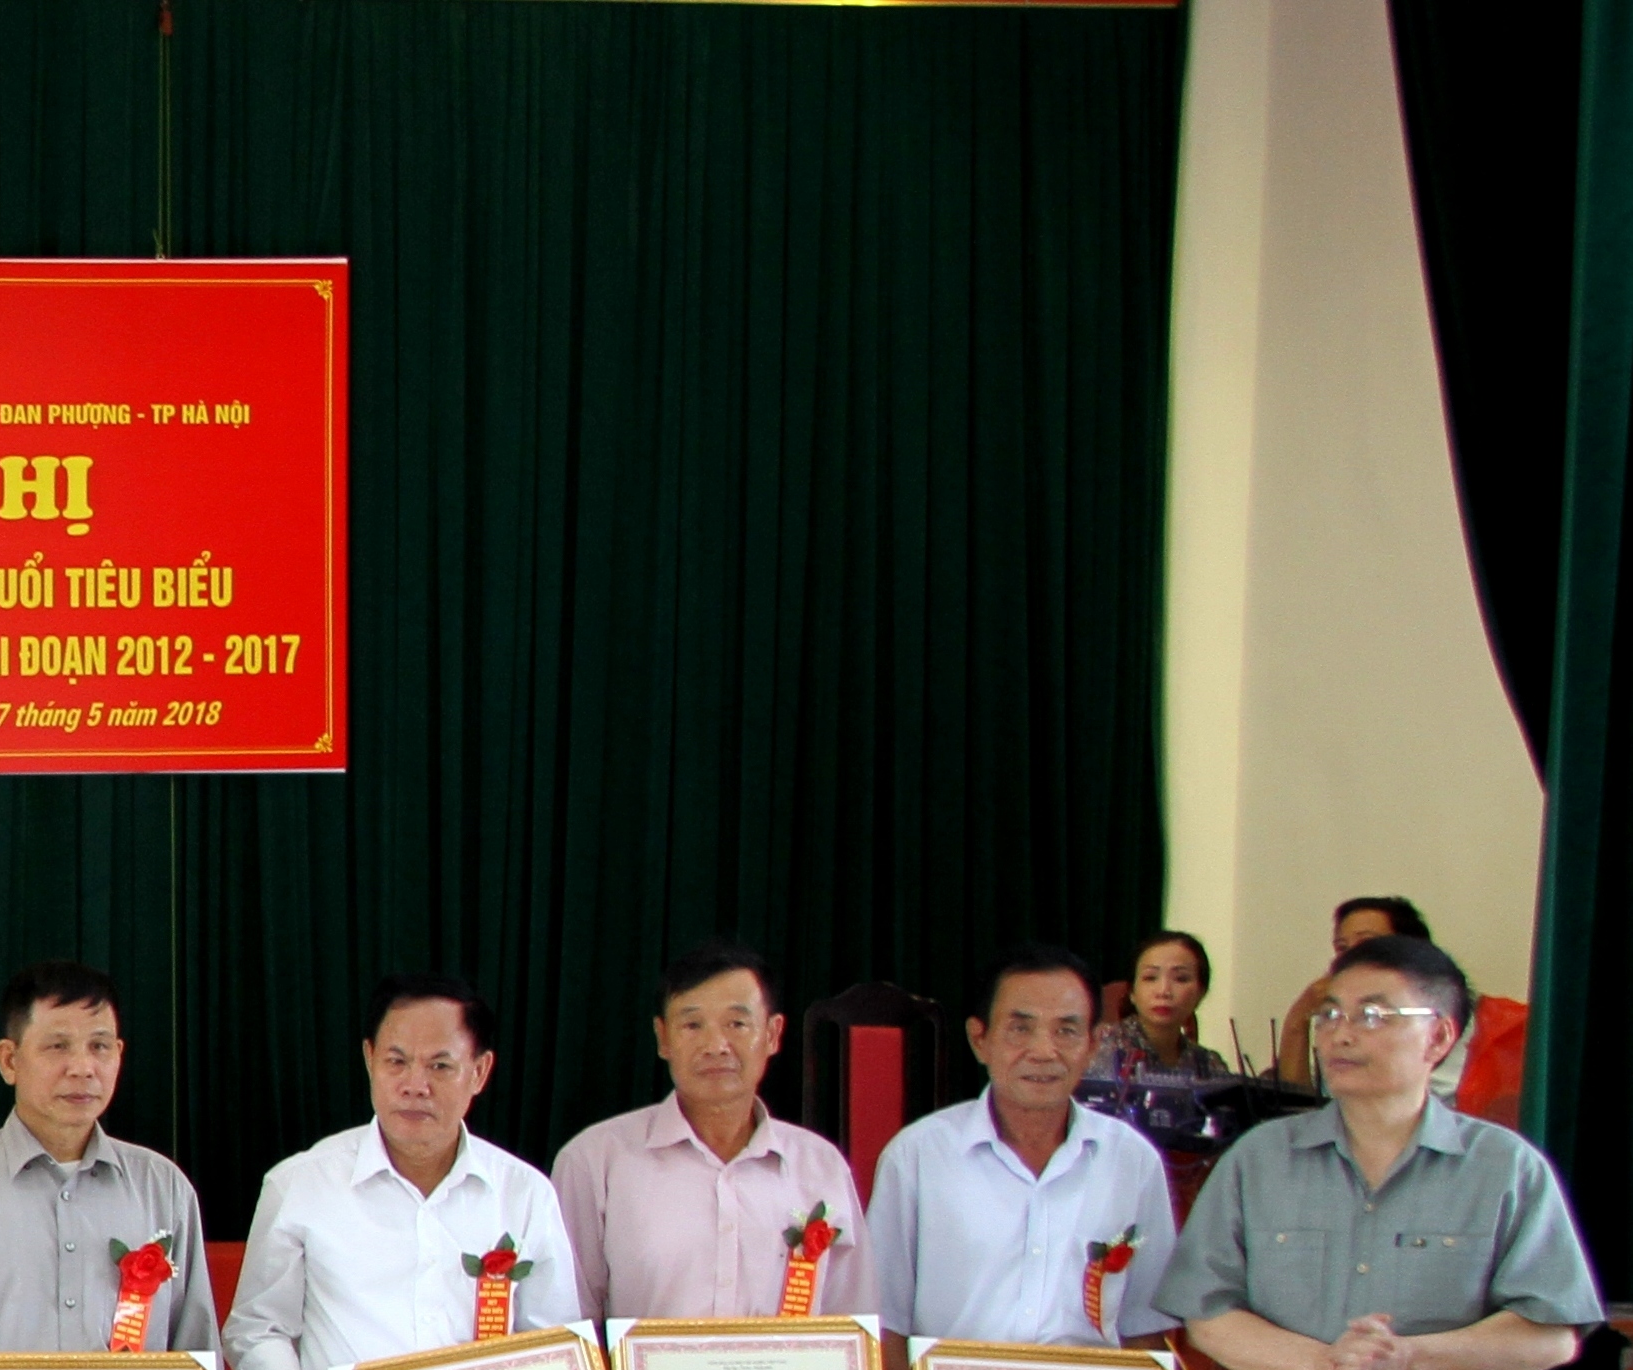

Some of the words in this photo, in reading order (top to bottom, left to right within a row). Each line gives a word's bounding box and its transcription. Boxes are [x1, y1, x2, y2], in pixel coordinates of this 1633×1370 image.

[0, 403, 42, 425] ĐAN
[48, 402, 131, 429] PHƯỢNG
[151, 404, 176, 424] TP
[182, 400, 209, 425] HÀ
[215, 400, 250, 429] NỘI
[64, 559, 141, 609] TIÊU
[153, 550, 233, 608] BIỂU
[18, 635, 107, 685] ĐOẠN
[116, 635, 193, 676] 2012
[224, 634, 301, 675] 2017
[15, 701, 82, 733] tháng
[86, 702, 103, 727] 5
[106, 702, 158, 727] năm
[162, 700, 223, 726] 2018
